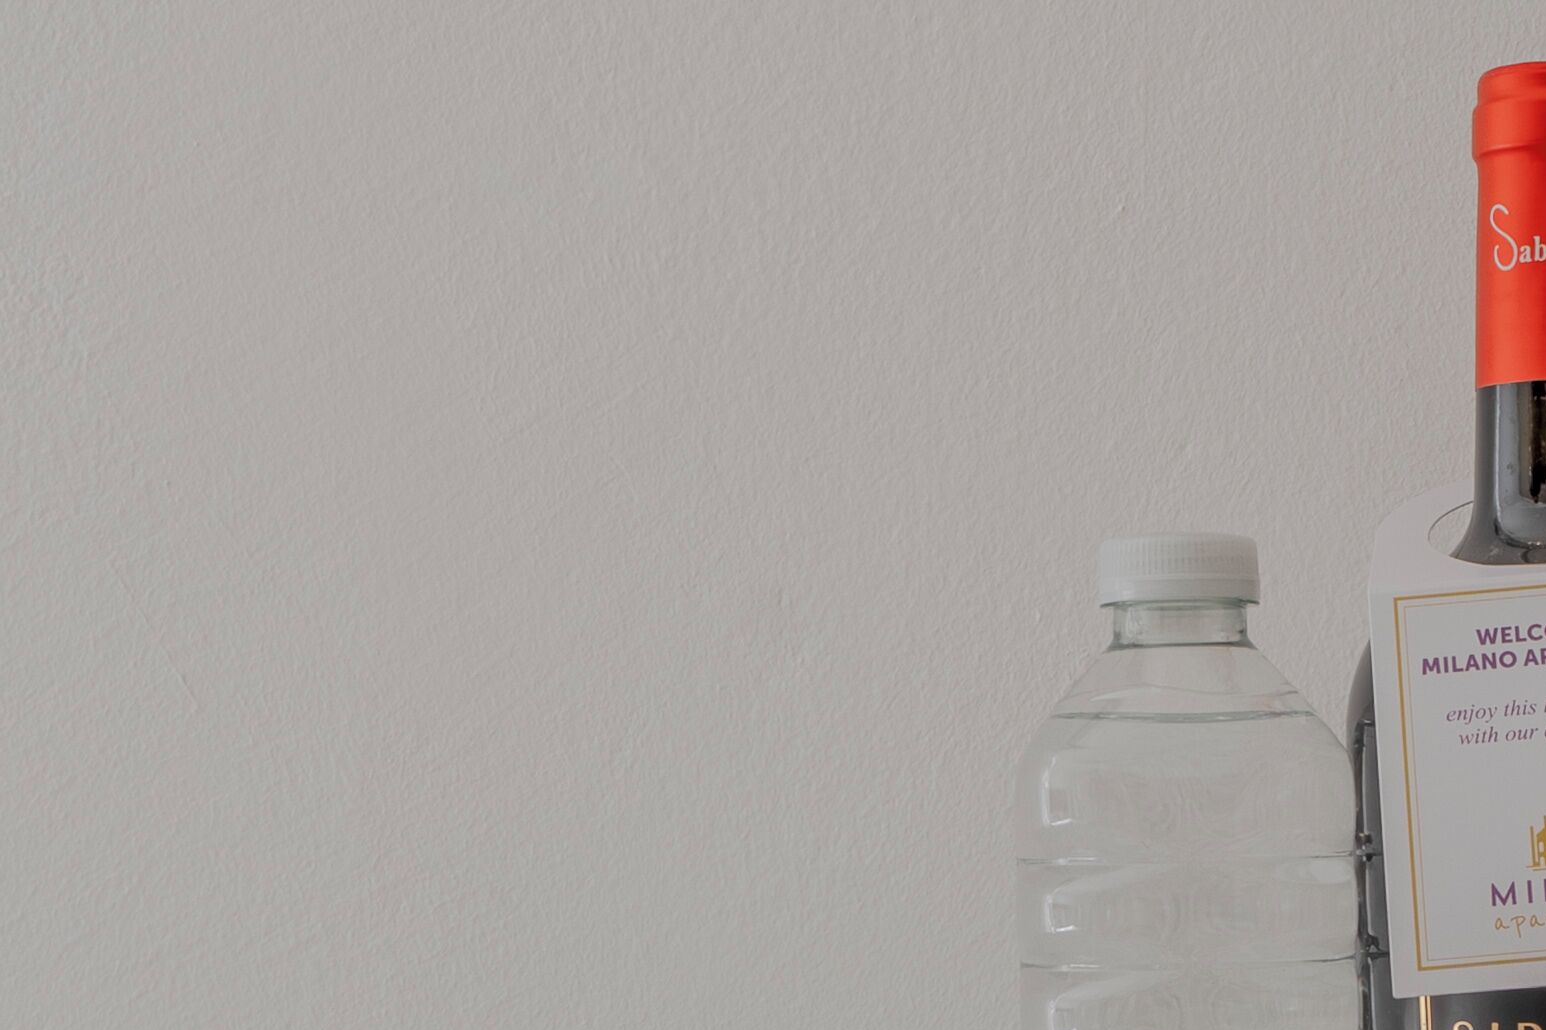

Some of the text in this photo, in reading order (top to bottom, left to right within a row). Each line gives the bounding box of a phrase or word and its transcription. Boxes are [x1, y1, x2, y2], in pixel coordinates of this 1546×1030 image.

[1421, 650, 1517, 676] MILANO
[1446, 705, 1497, 725] enjoy
[1503, 699, 1537, 718] this
[1458, 728, 1499, 745] with
[1505, 727, 1539, 742] our
